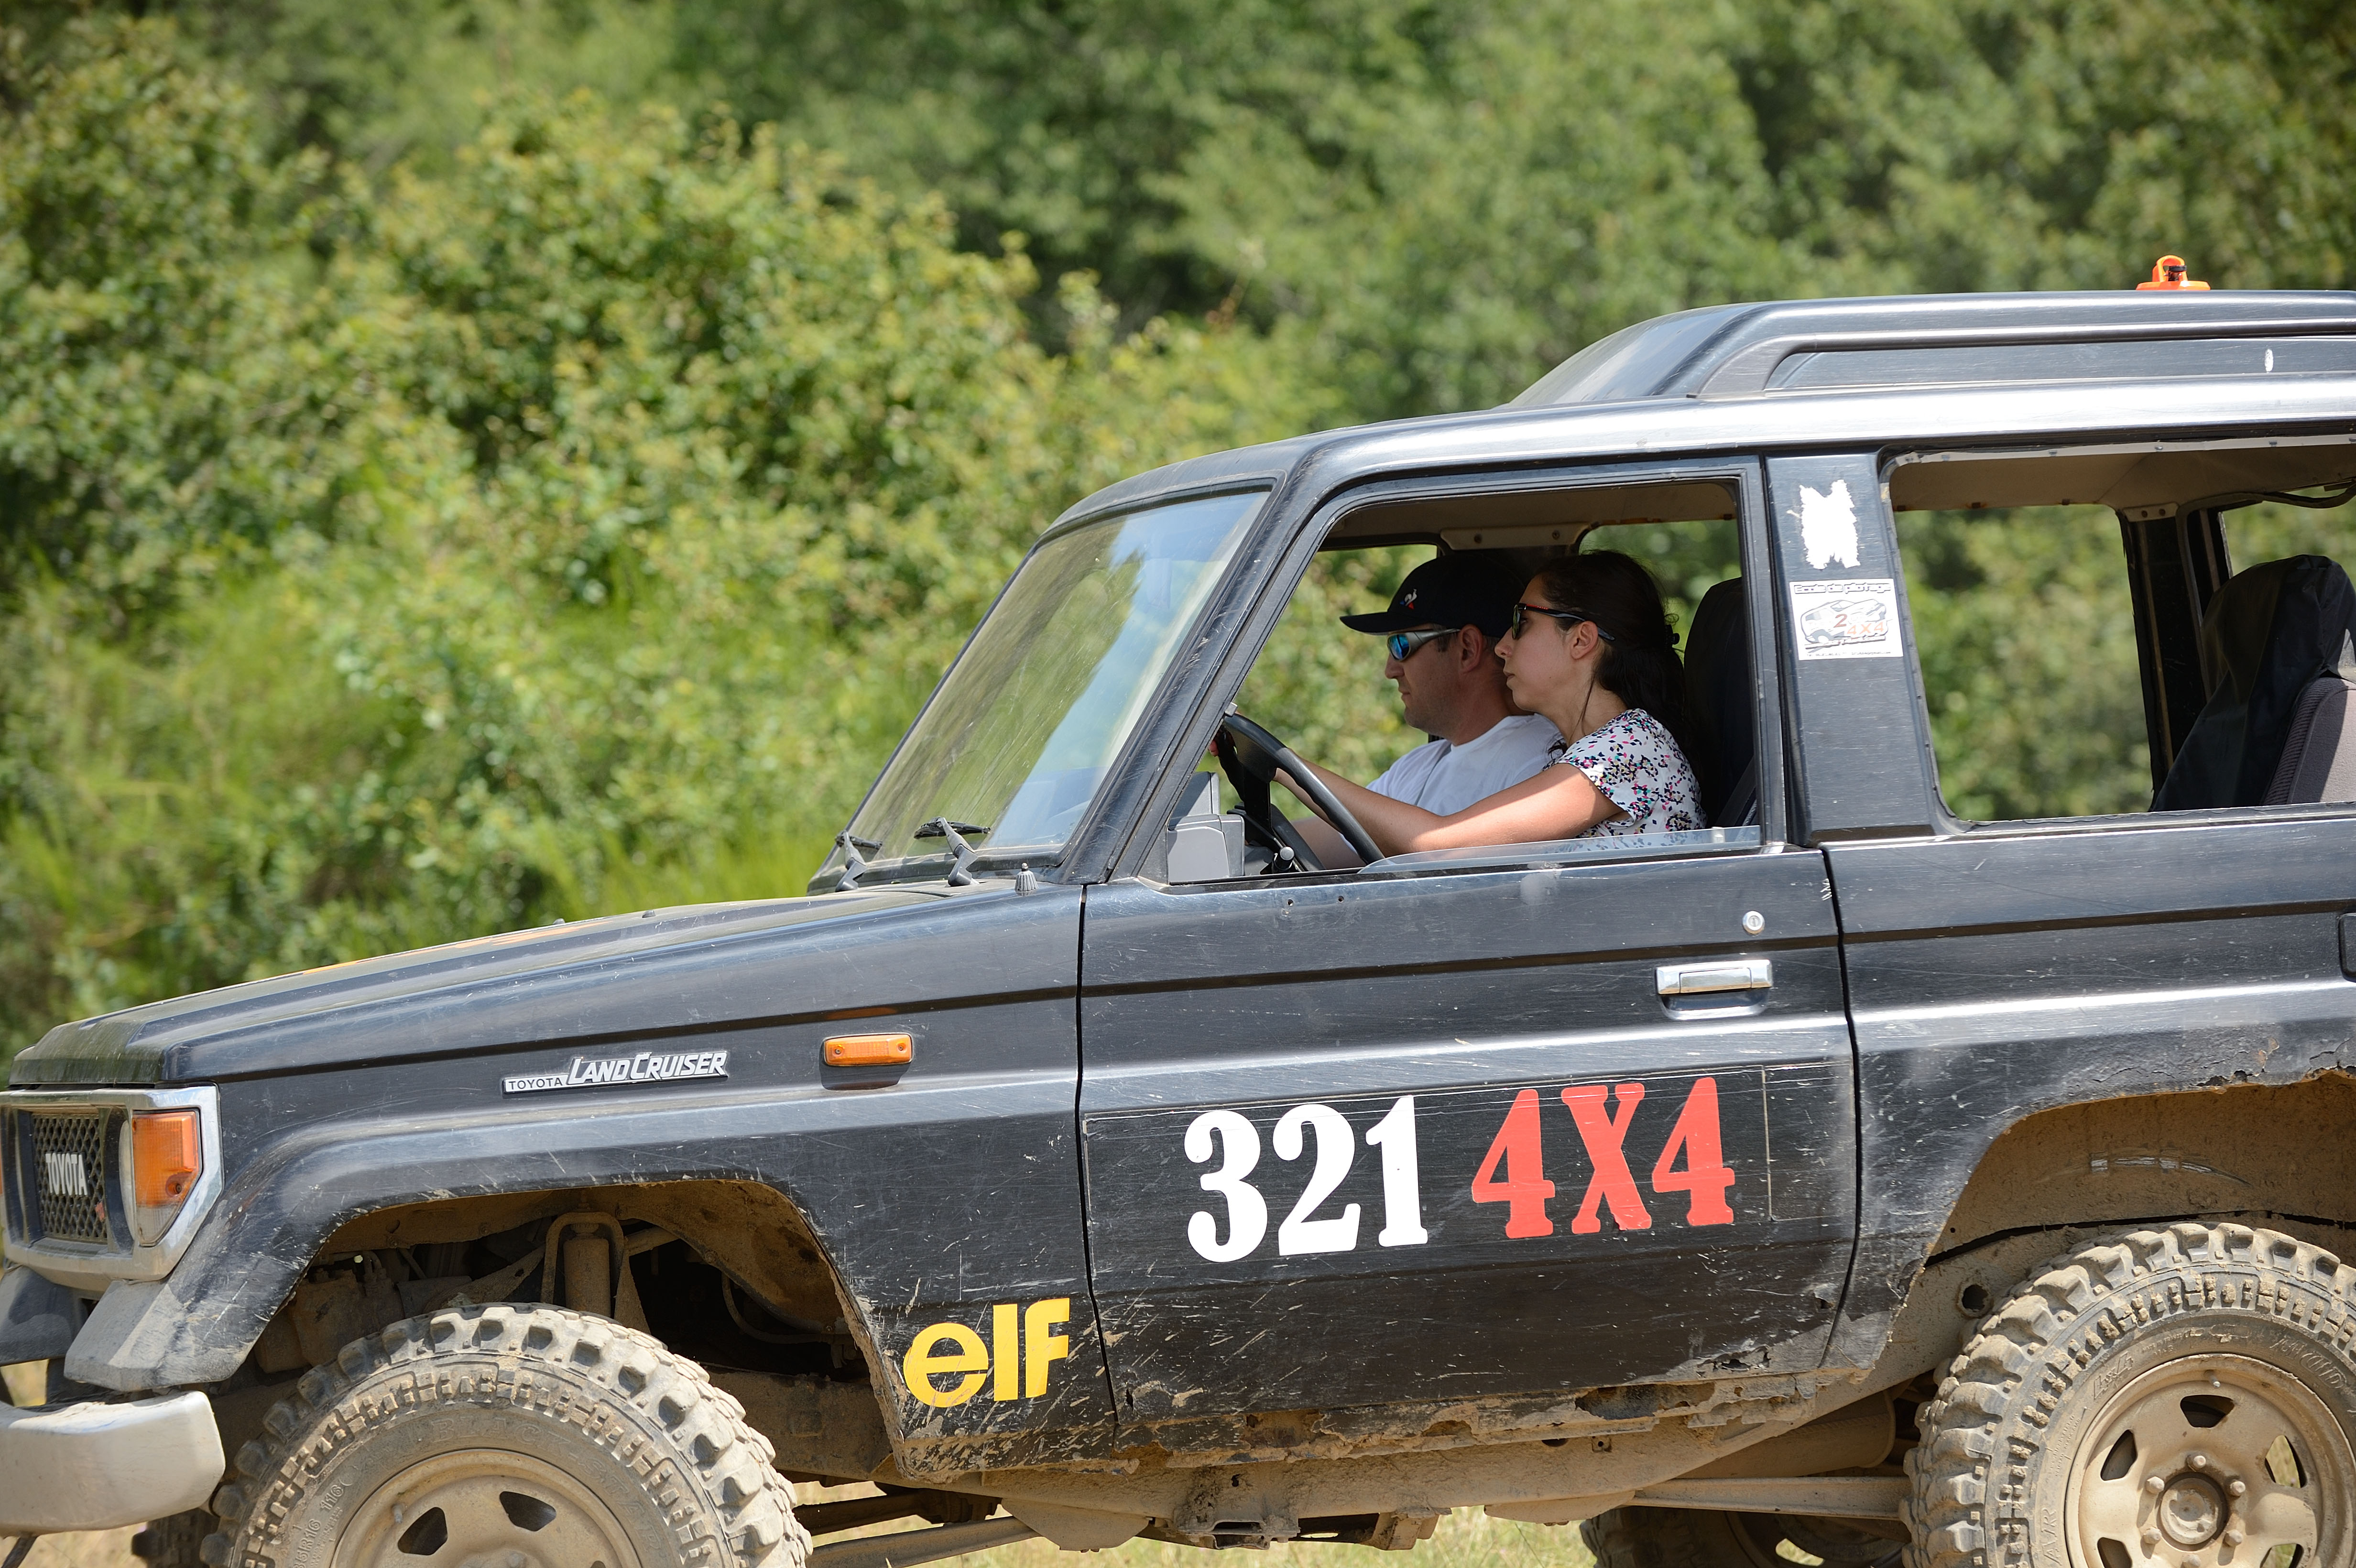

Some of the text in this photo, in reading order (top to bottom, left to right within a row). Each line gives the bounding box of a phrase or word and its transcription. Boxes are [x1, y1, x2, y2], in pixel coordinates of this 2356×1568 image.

[1827, 583, 1843, 593] de
[508, 1077, 563, 1090] TOYOTA
[45, 1153, 88, 1195] TOYOTA
[1184, 1077, 1735, 1263] 321 4X4
[903, 1297, 1070, 1408] elf
[319, 1484, 345, 1511] 116
